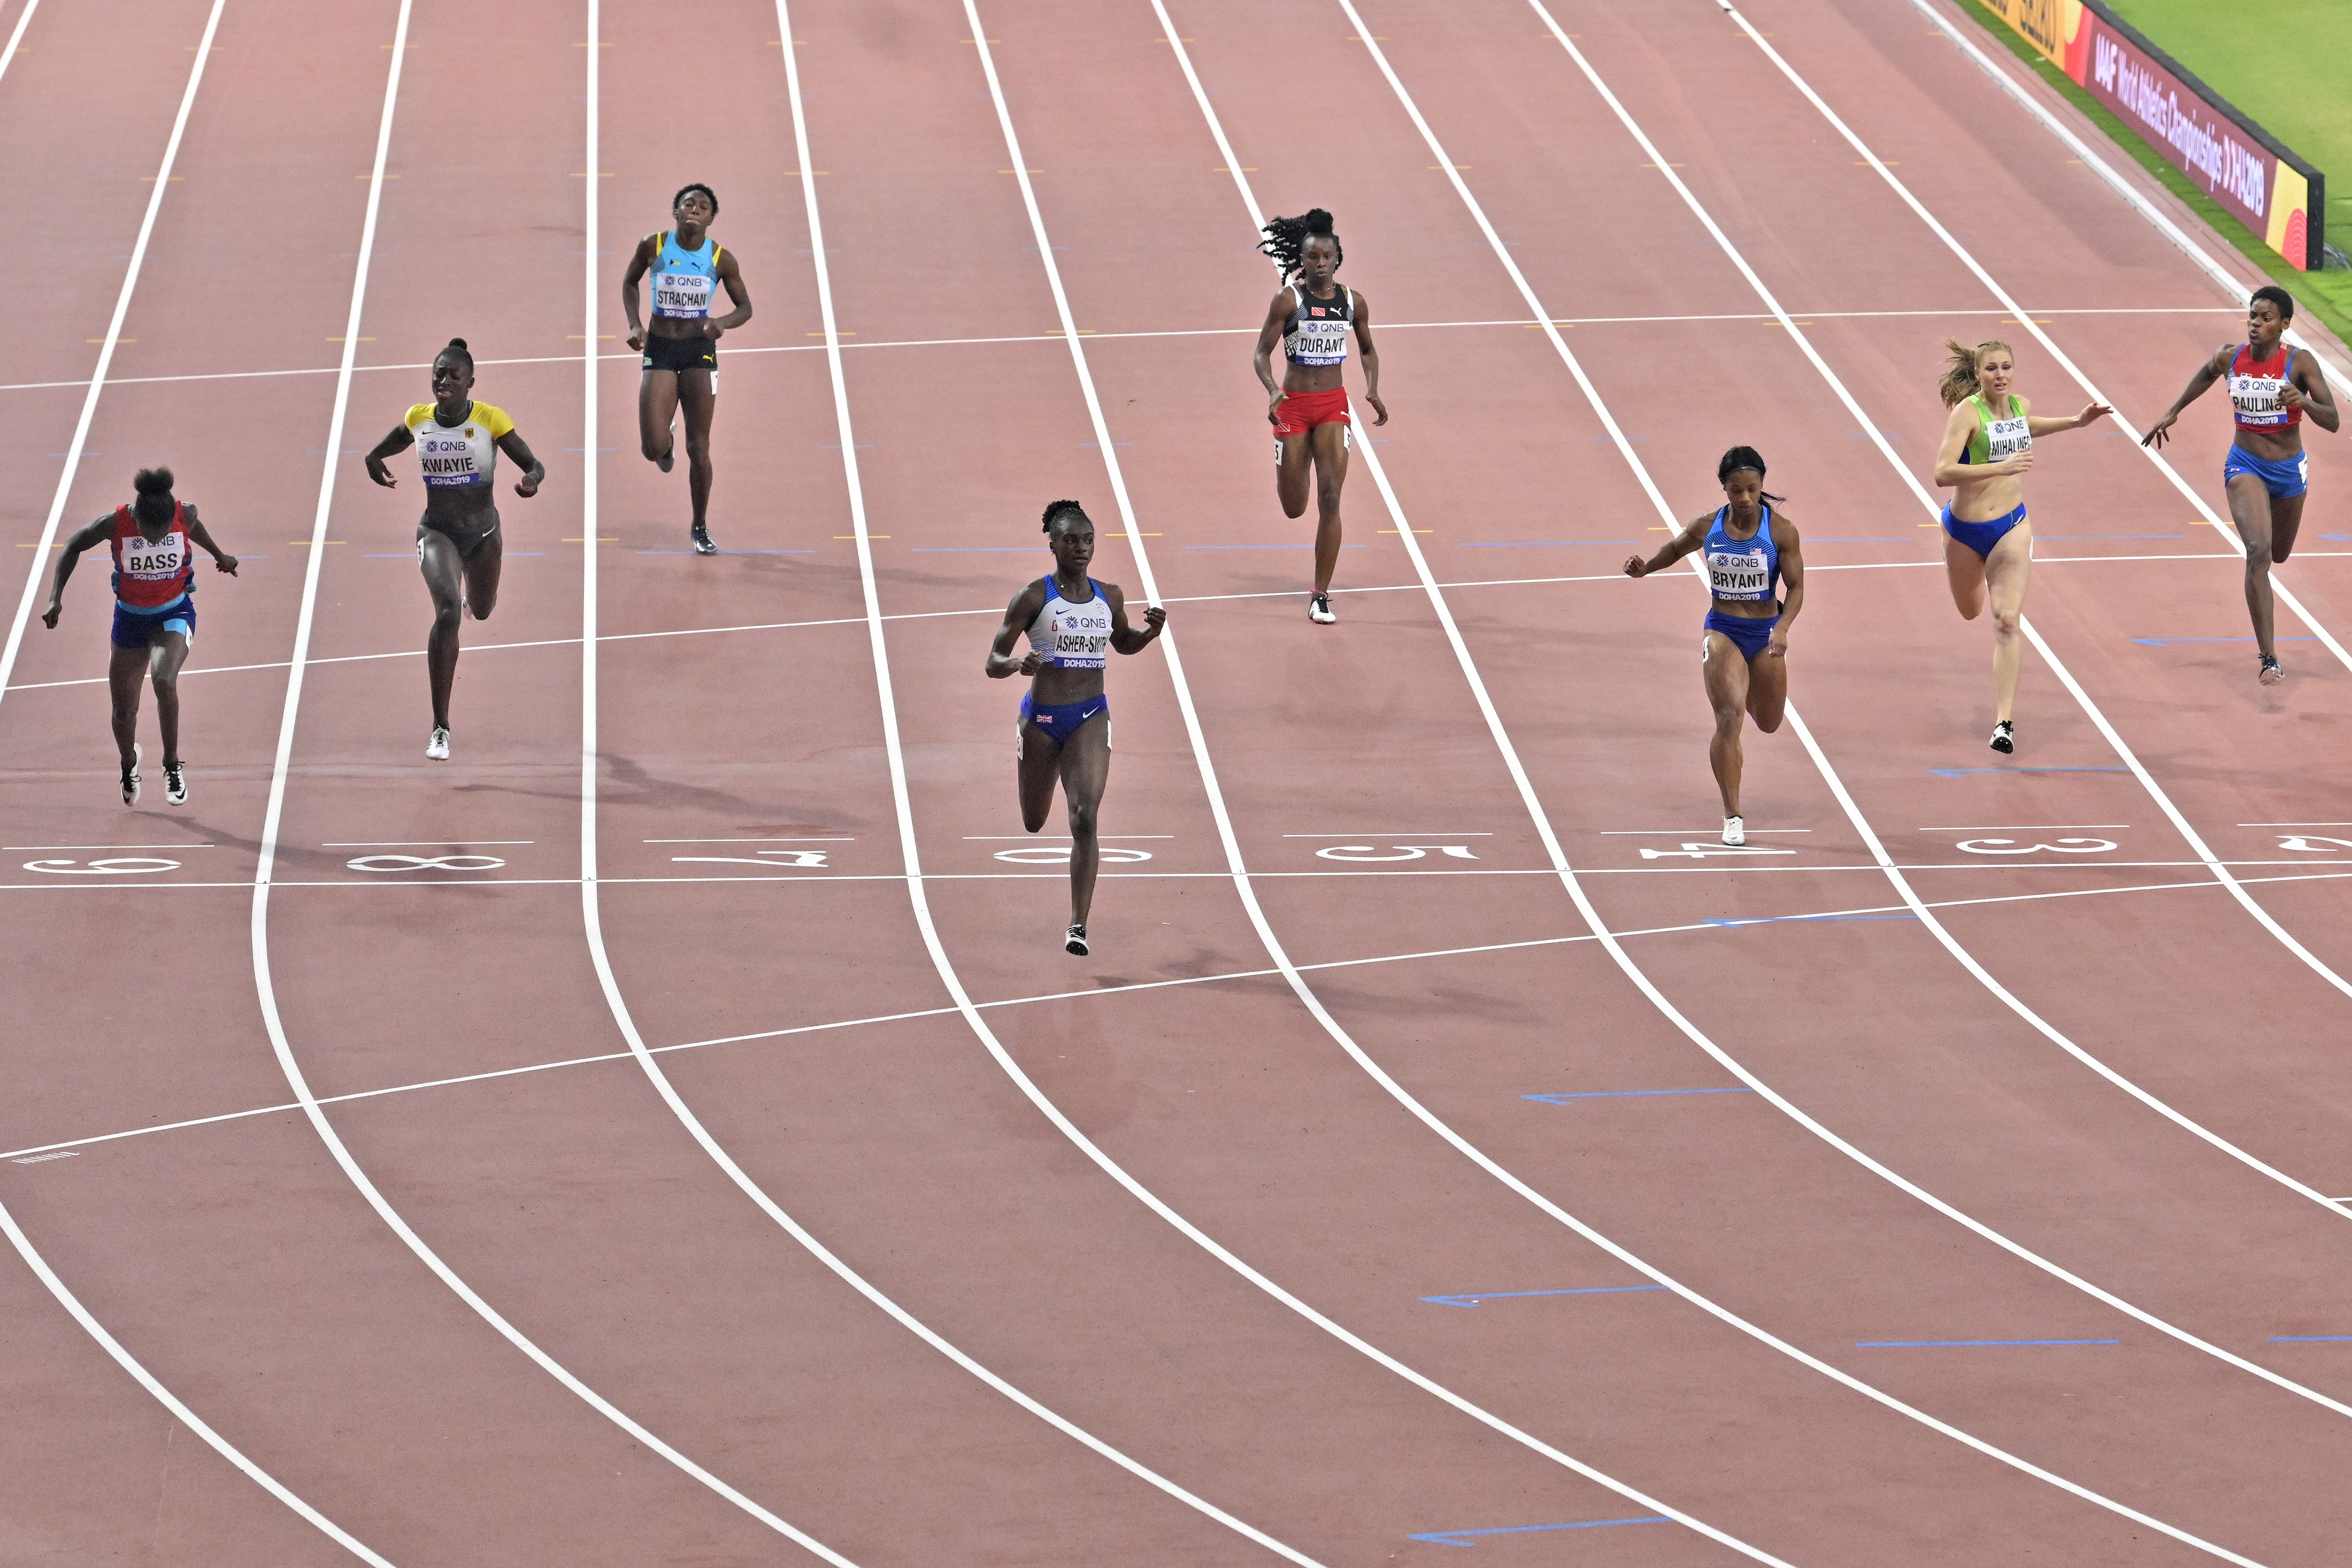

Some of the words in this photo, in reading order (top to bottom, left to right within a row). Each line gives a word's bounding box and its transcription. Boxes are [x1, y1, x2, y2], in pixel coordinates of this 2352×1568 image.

[2095, 33, 2118, 92] IAAF
[2117, 49, 2139, 112] World
[2136, 68, 2167, 137] Athletics
[2167, 90, 2223, 192] Championships
[678, 277, 702, 287] QNB
[658, 292, 706, 307] STRACHAN
[664, 310, 699, 318] DOHA2019
[1320, 324, 1344, 332] QNB
[1299, 338, 1345, 353] DURANT
[2252, 381, 2276, 391] QNB
[2004, 420, 2024, 432] QNB
[2242, 416, 2278, 424] DOHA2019
[440, 441, 466, 452] QNB
[422, 457, 474, 473] KWAYIE
[431, 475, 470, 485] DOHA2019
[131, 553, 177, 571] BASS
[1731, 557, 1759, 567] QNB
[133, 572, 174, 581] DOHA2019
[1712, 571, 1764, 588] BRYANT
[1081, 618, 1106, 628] QNB
[1056, 635, 1107, 653] ASHER-SMITH
[1064, 659, 1105, 668] DOHA2019
[1316, 846, 1480, 861] 5
[1639, 843, 1796, 859] 4
[1957, 838, 2117, 854] 3
[672, 851, 828, 867] 7
[994, 847, 1152, 863] 6
[347, 855, 504, 871] 8
